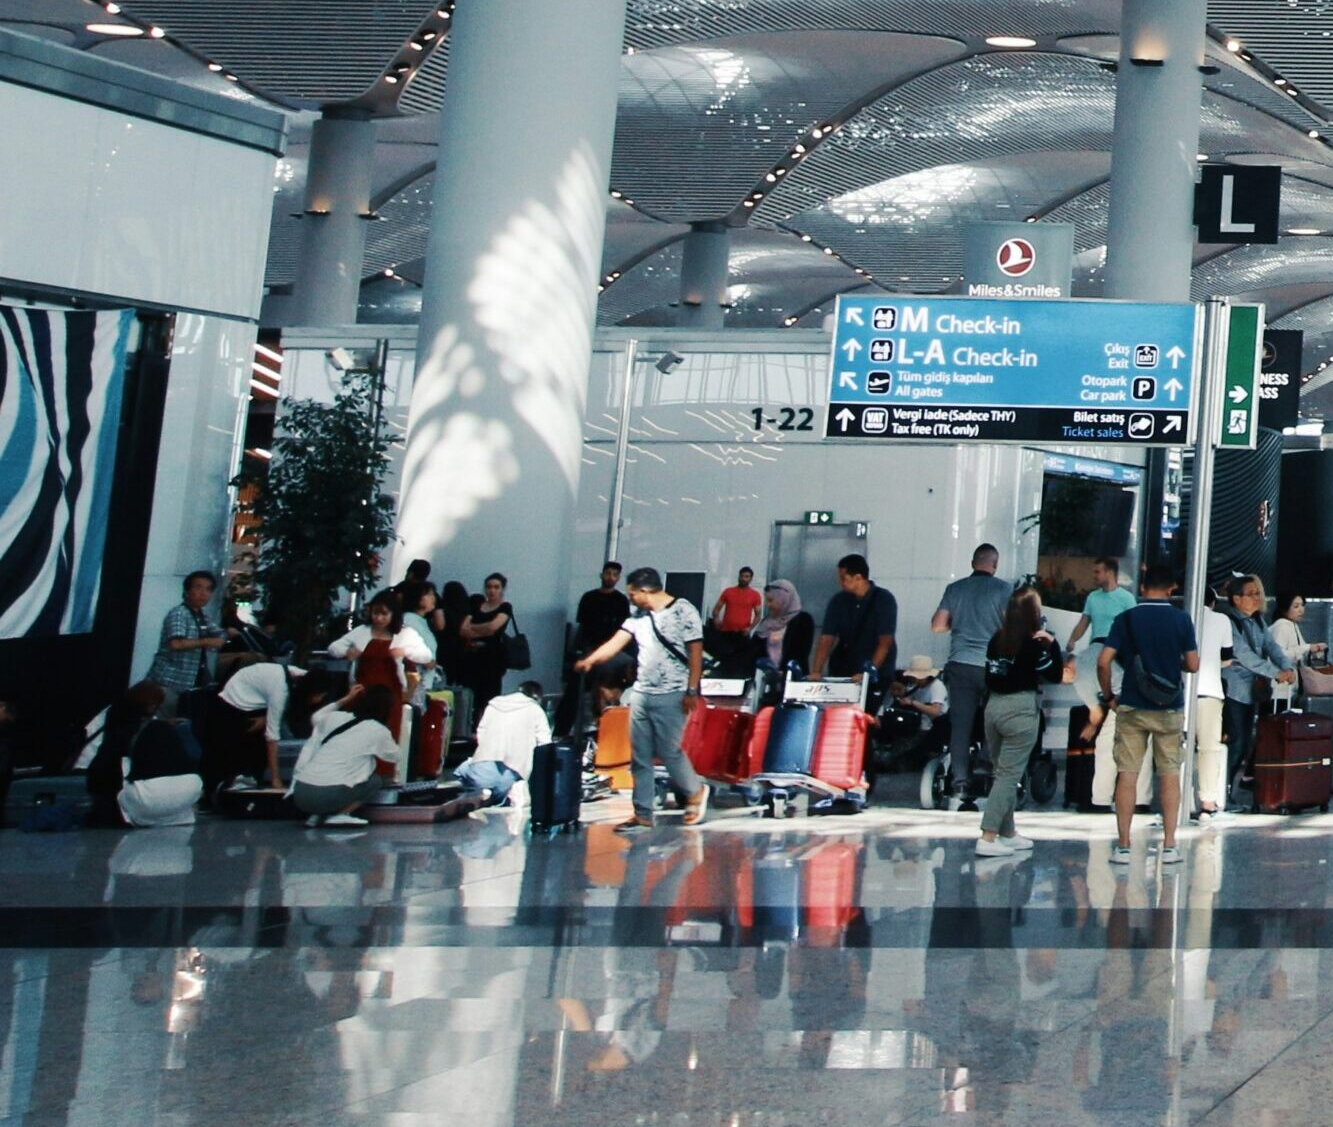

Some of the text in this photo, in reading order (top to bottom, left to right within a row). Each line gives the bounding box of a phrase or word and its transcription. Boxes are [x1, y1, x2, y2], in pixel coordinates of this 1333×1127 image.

[1220, 175, 1255, 232] L
[968, 284, 1060, 297] Miles&Smiles
[901, 306, 1021, 334] M Check-in
[898, 338, 1038, 367] L-A Check-in
[1108, 358, 1129, 369] Exit
[898, 370, 922, 382] Tüm
[1081, 375, 1127, 388] Otopark
[1260, 373, 1289, 385] NESS
[895, 385, 943, 399] All gates
[1080, 390, 1126, 403] Car park
[1259, 387, 1279, 399] ASS
[752, 407, 814, 431] 1-22
[892, 408, 922, 422] Vergi
[1073, 411, 1098, 423] Bilet
[892, 423, 909, 435] Tax
[911, 424, 931, 435] free
[952, 424, 979, 437] only)
[1062, 426, 1124, 438] Ticket sales
